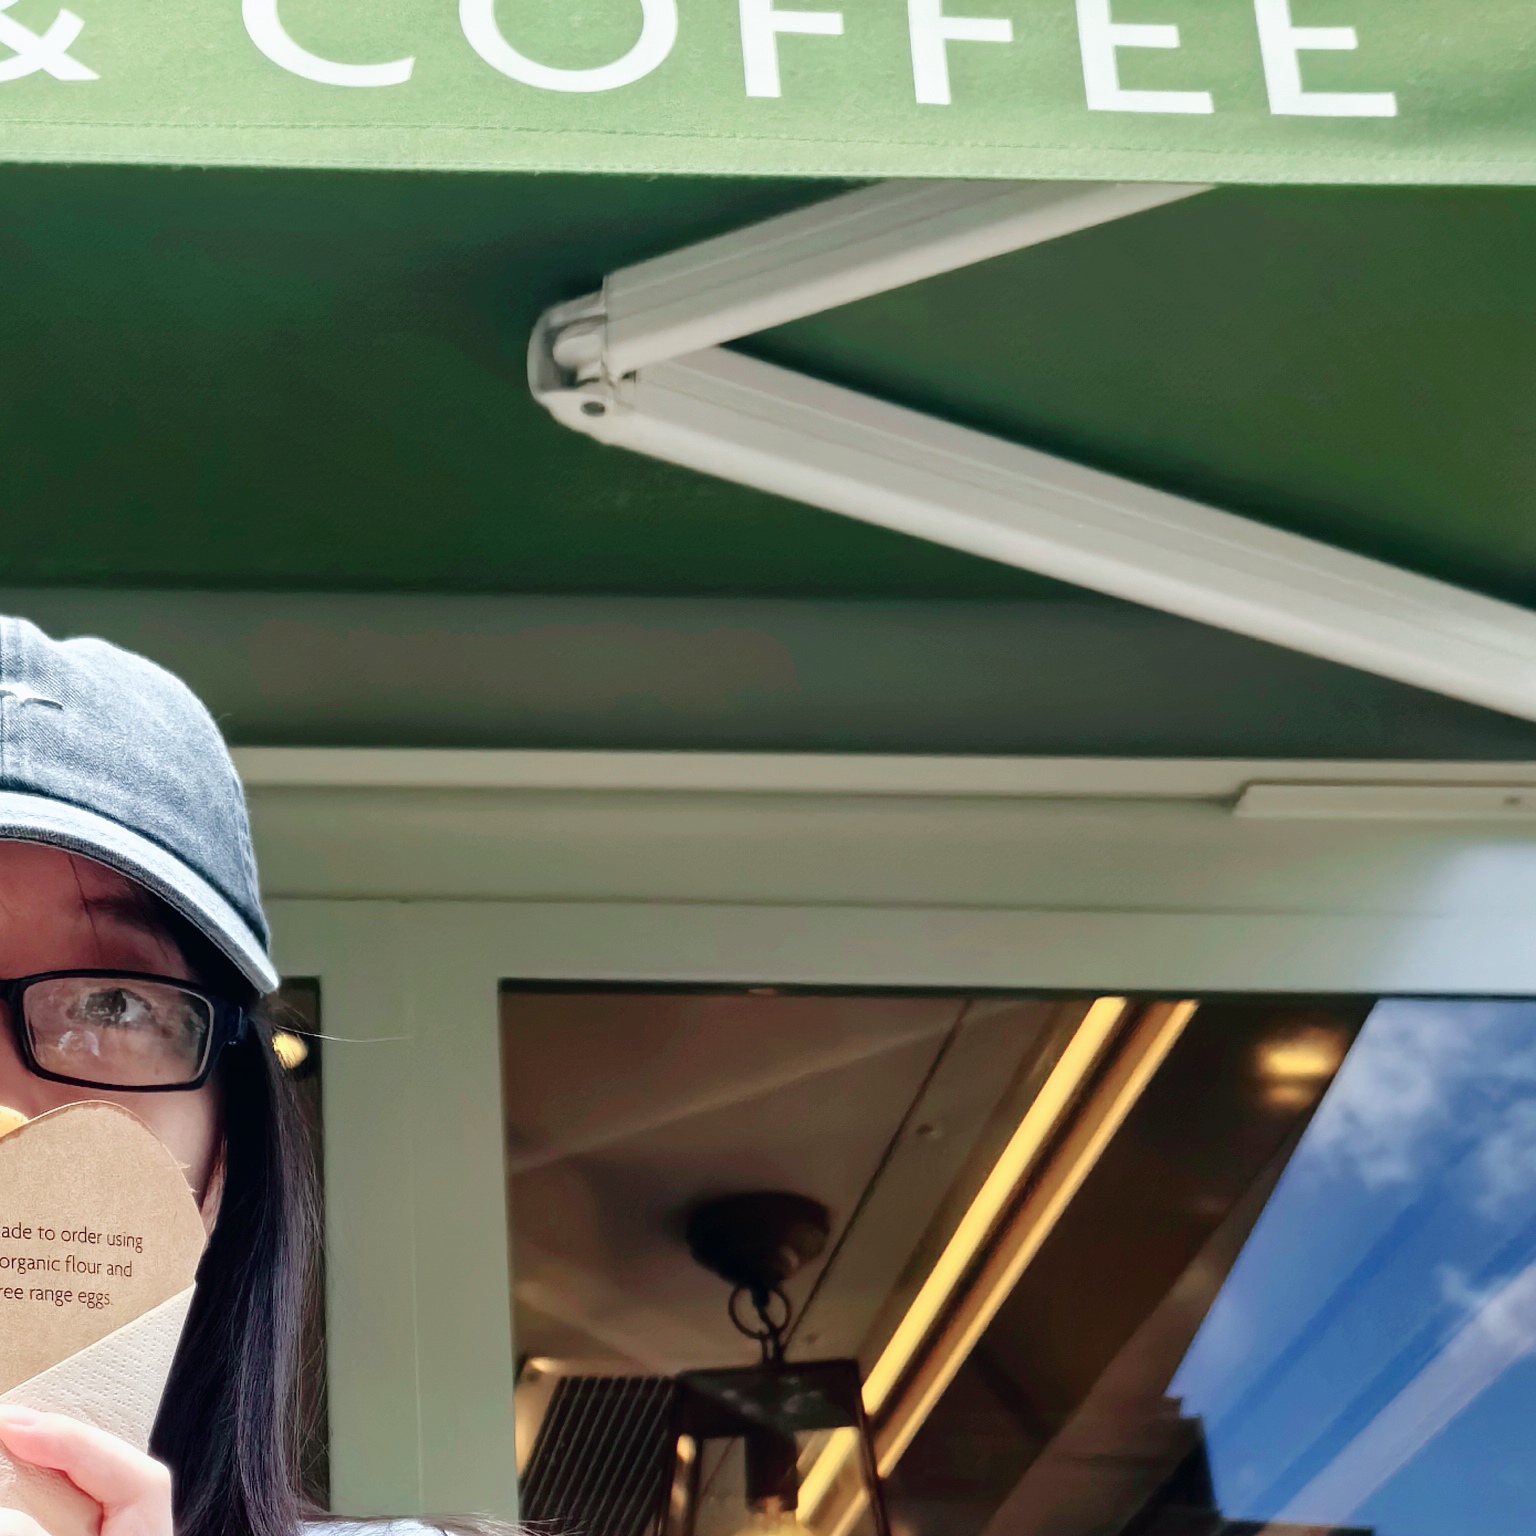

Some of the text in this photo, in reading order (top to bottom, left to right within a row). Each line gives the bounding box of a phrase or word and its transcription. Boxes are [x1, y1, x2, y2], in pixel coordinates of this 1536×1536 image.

[242, 0, 1397, 117] COFFEE
[37, 1225, 56, 1242] to
[60, 1227, 102, 1244] order
[106, 1231, 144, 1254] using
[65, 1255, 102, 1274] flour
[106, 1260, 133, 1277] and
[29, 1285, 73, 1307] range
